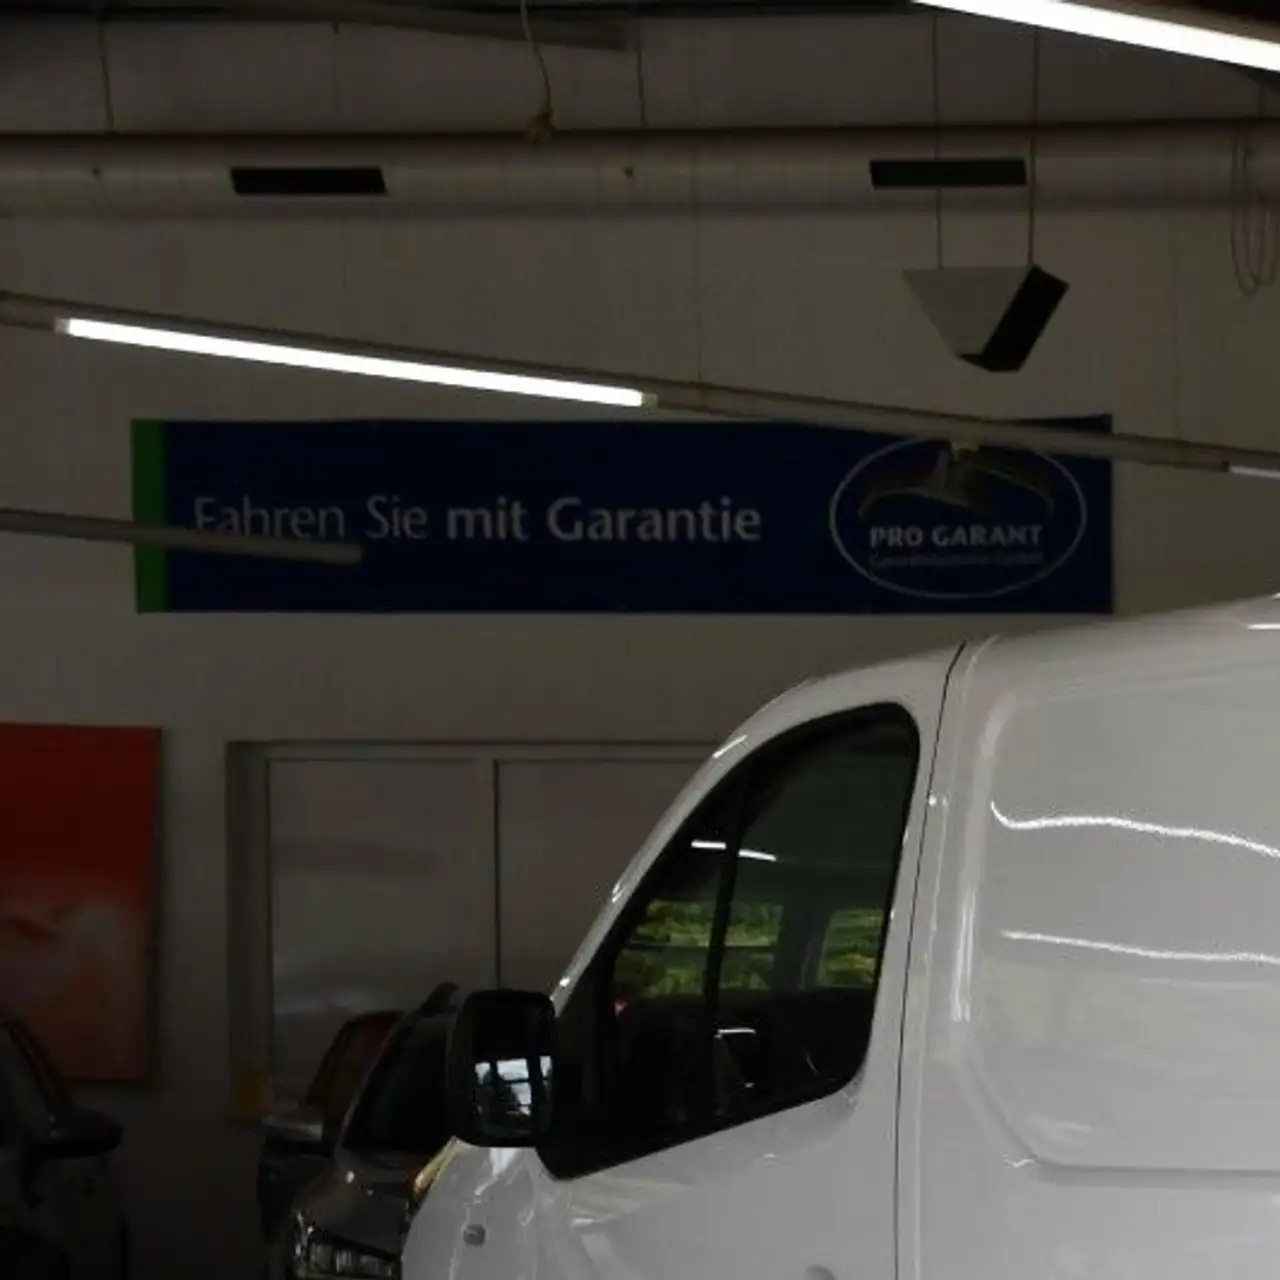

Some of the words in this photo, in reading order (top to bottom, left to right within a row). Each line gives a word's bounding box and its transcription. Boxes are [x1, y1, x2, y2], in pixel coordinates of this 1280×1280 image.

[192, 494, 346, 541] Fahren
[365, 493, 428, 541] Sie
[446, 494, 531, 542] mit
[546, 495, 762, 543] Garantie
[868, 524, 926, 549] PRO
[930, 522, 1044, 548] GARANT
